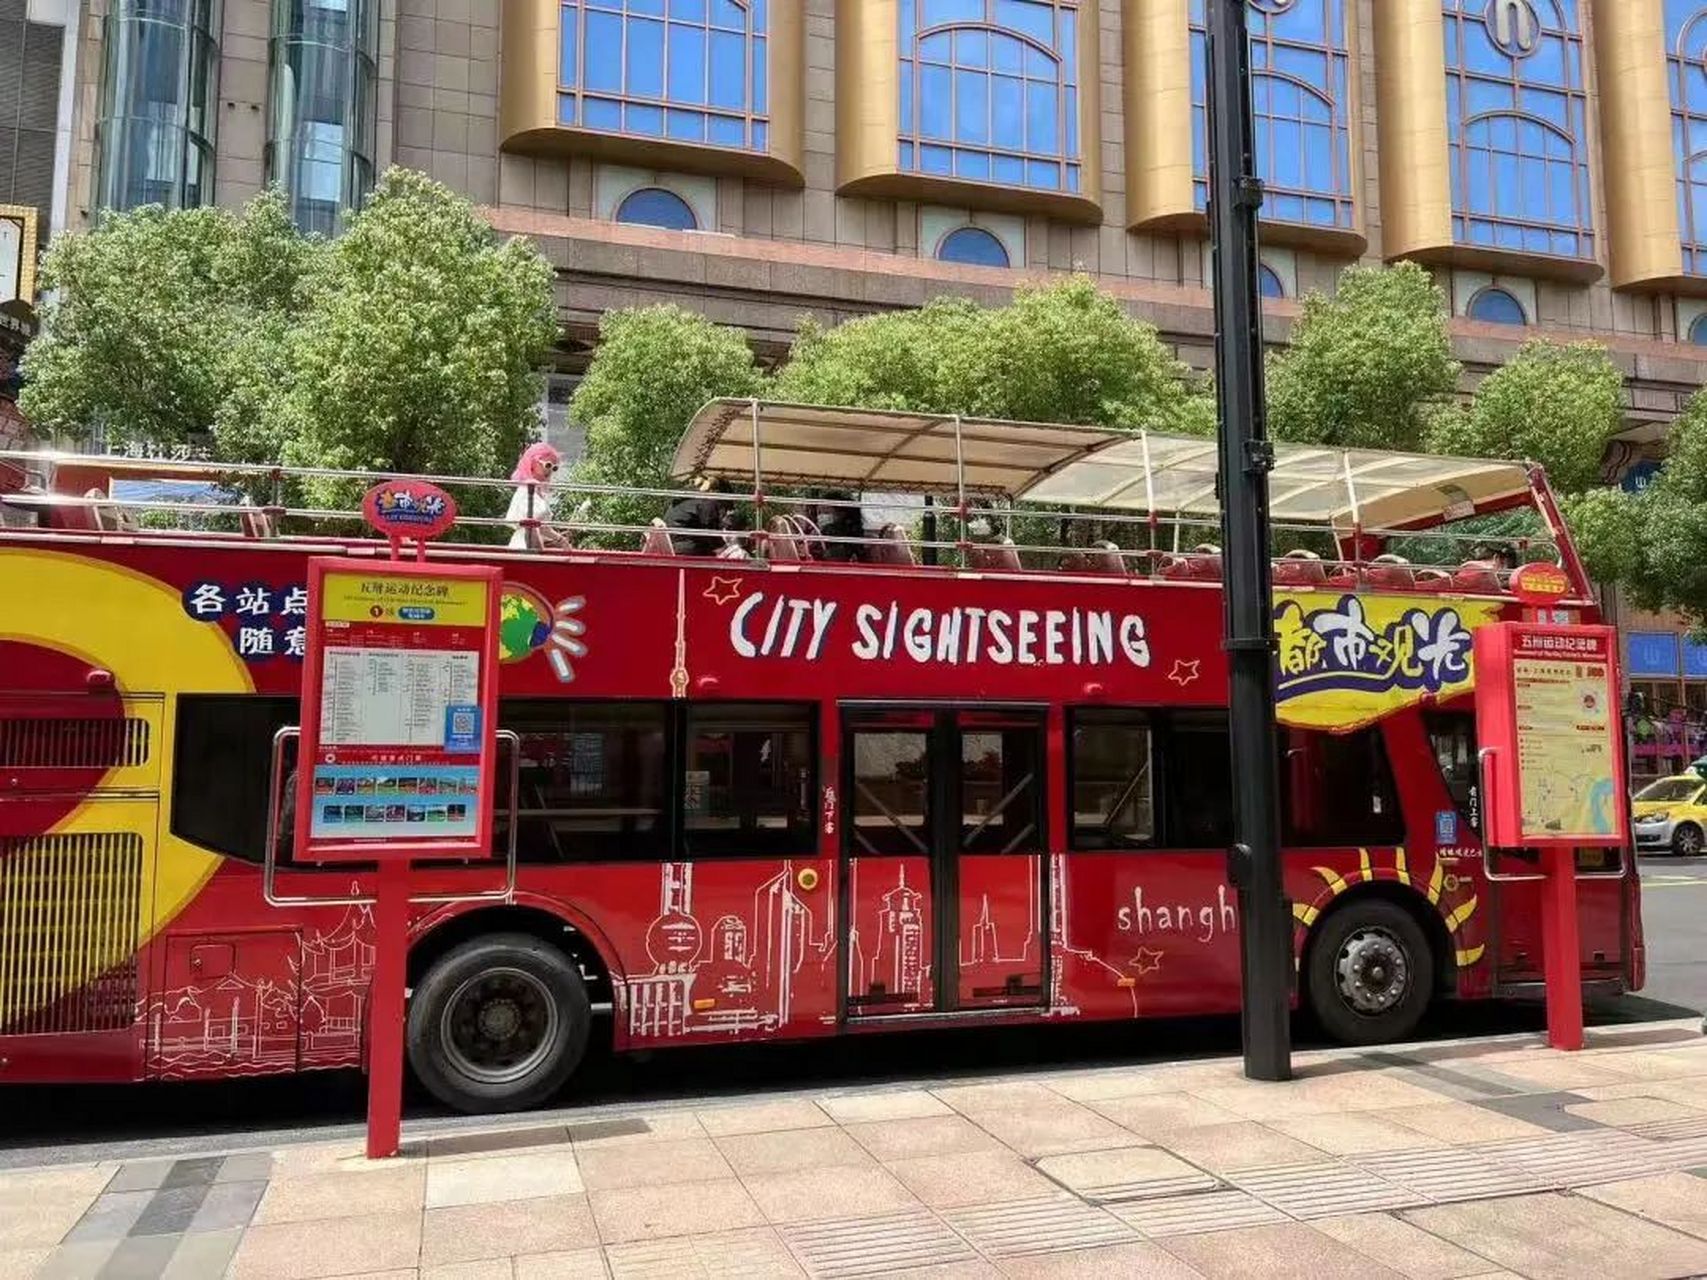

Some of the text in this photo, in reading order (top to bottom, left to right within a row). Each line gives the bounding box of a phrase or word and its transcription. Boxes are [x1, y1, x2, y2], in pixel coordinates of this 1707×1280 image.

[190, 583, 308, 615] 各站点
[240, 626, 306, 655] 随意
[730, 591, 1151, 668] CITY SIGHTSEEING
[1273, 597, 1472, 684] 都市观光
[1118, 885, 1236, 942] shangh
